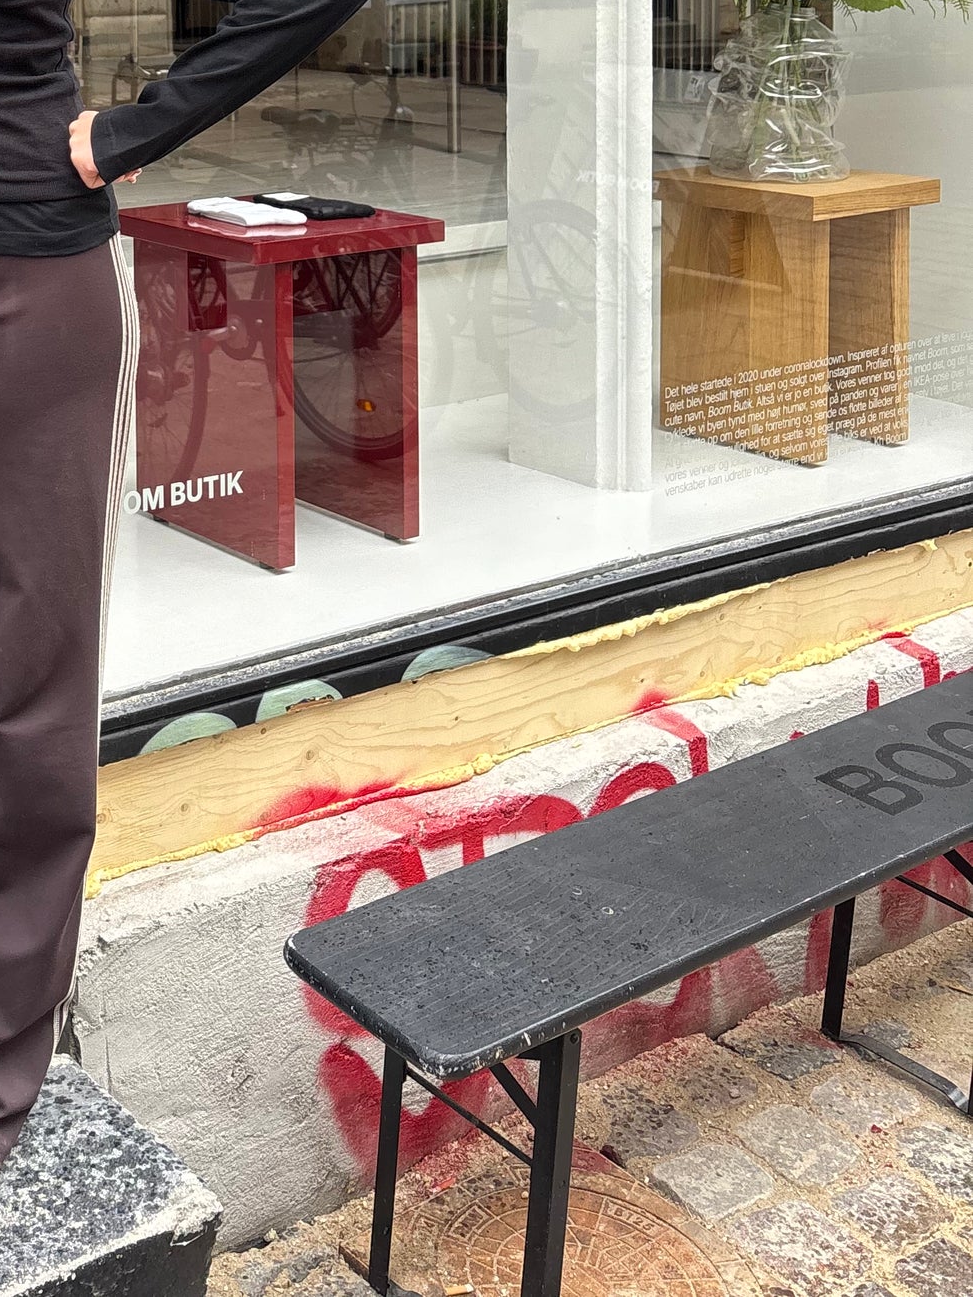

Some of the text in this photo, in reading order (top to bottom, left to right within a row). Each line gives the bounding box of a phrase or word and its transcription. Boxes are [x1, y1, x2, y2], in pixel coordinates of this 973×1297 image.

[664, 385, 679, 398] Det
[681, 381, 698, 395] hele
[699, 375, 732, 391] startede
[738, 369, 758, 383] 2020
[760, 365, 781, 379] under
[783, 354, 845, 374] coronalockdown.
[847, 345, 879, 362] Inspireret
[880, 343, 888, 355] af
[917, 337, 932, 348] over
[664, 414, 682, 427] cute
[684, 410, 705, 422] navn,
[708, 404, 731, 417] Boom
[755, 392, 774, 407] Altså
[777, 391, 783, 402] vi
[784, 391, 792, 401] er
[793, 388, 801, 402] jo
[803, 387, 812, 397] en
[835, 378, 856, 390] Vores
[857, 373, 882, 386] venner
[883, 370, 895, 381] tog
[896, 365, 912, 380] godt
[946, 358, 955, 369] og
[665, 398, 684, 413] Tøjet
[686, 395, 702, 408] blev
[704, 389, 728, 404] bestilt
[729, 387, 749, 401] hjem
[754, 381, 775, 394] stuen
[777, 379, 787, 391] og
[789, 373, 807, 387] solgt
[809, 371, 825, 382] over
[865, 357, 891, 371] Profilen
[893, 354, 901, 365] fik
[903, 349, 926, 363] navnet
[698, 421, 704, 433] vi
[706, 418, 726, 433] byen
[728, 412, 745, 428] tynd
[747, 408, 765, 422] med
[766, 405, 781, 419] højt
[809, 395, 827, 409] sved
[829, 392, 838, 407] på
[840, 388, 867, 405] panden
[868, 386, 878, 398] og
[903, 379, 912, 389] en
[707, 434, 718, 446] op
[719, 431, 732, 442] om
[734, 427, 749, 439] den
[751, 422, 763, 435] lille
[765, 416, 800, 432] forretning
[802, 414, 812, 425] og
[813, 407, 836, 421] sende
[838, 406, 847, 416] os
[848, 401, 866, 414] flotte
[868, 395, 893, 409] billeder
[894, 392, 901, 403] af
[760, 435, 771, 446] for
[772, 432, 780, 444] at
[782, 428, 803, 442] sætte
[804, 425, 815, 438] sig
[817, 420, 834, 435] eget
[835, 418, 854, 432] præg
[856, 413, 865, 427] på
[867, 411, 877, 422] de
[878, 406, 896, 420] mest
[665, 469, 686, 482] vores
[718, 460, 729, 472] og
[769, 448, 779, 460] og
[780, 442, 807, 456] selvom
[809, 437, 829, 449] vores
[859, 427, 868, 437] er
[868, 422, 882, 435] ved
[883, 420, 891, 431] at
[665, 478, 705, 497] venskaber
[708, 474, 722, 486] kan
[724, 467, 751, 482] udrette
[800, 450, 814, 463] end
[170, 470, 244, 507] BUTIK
